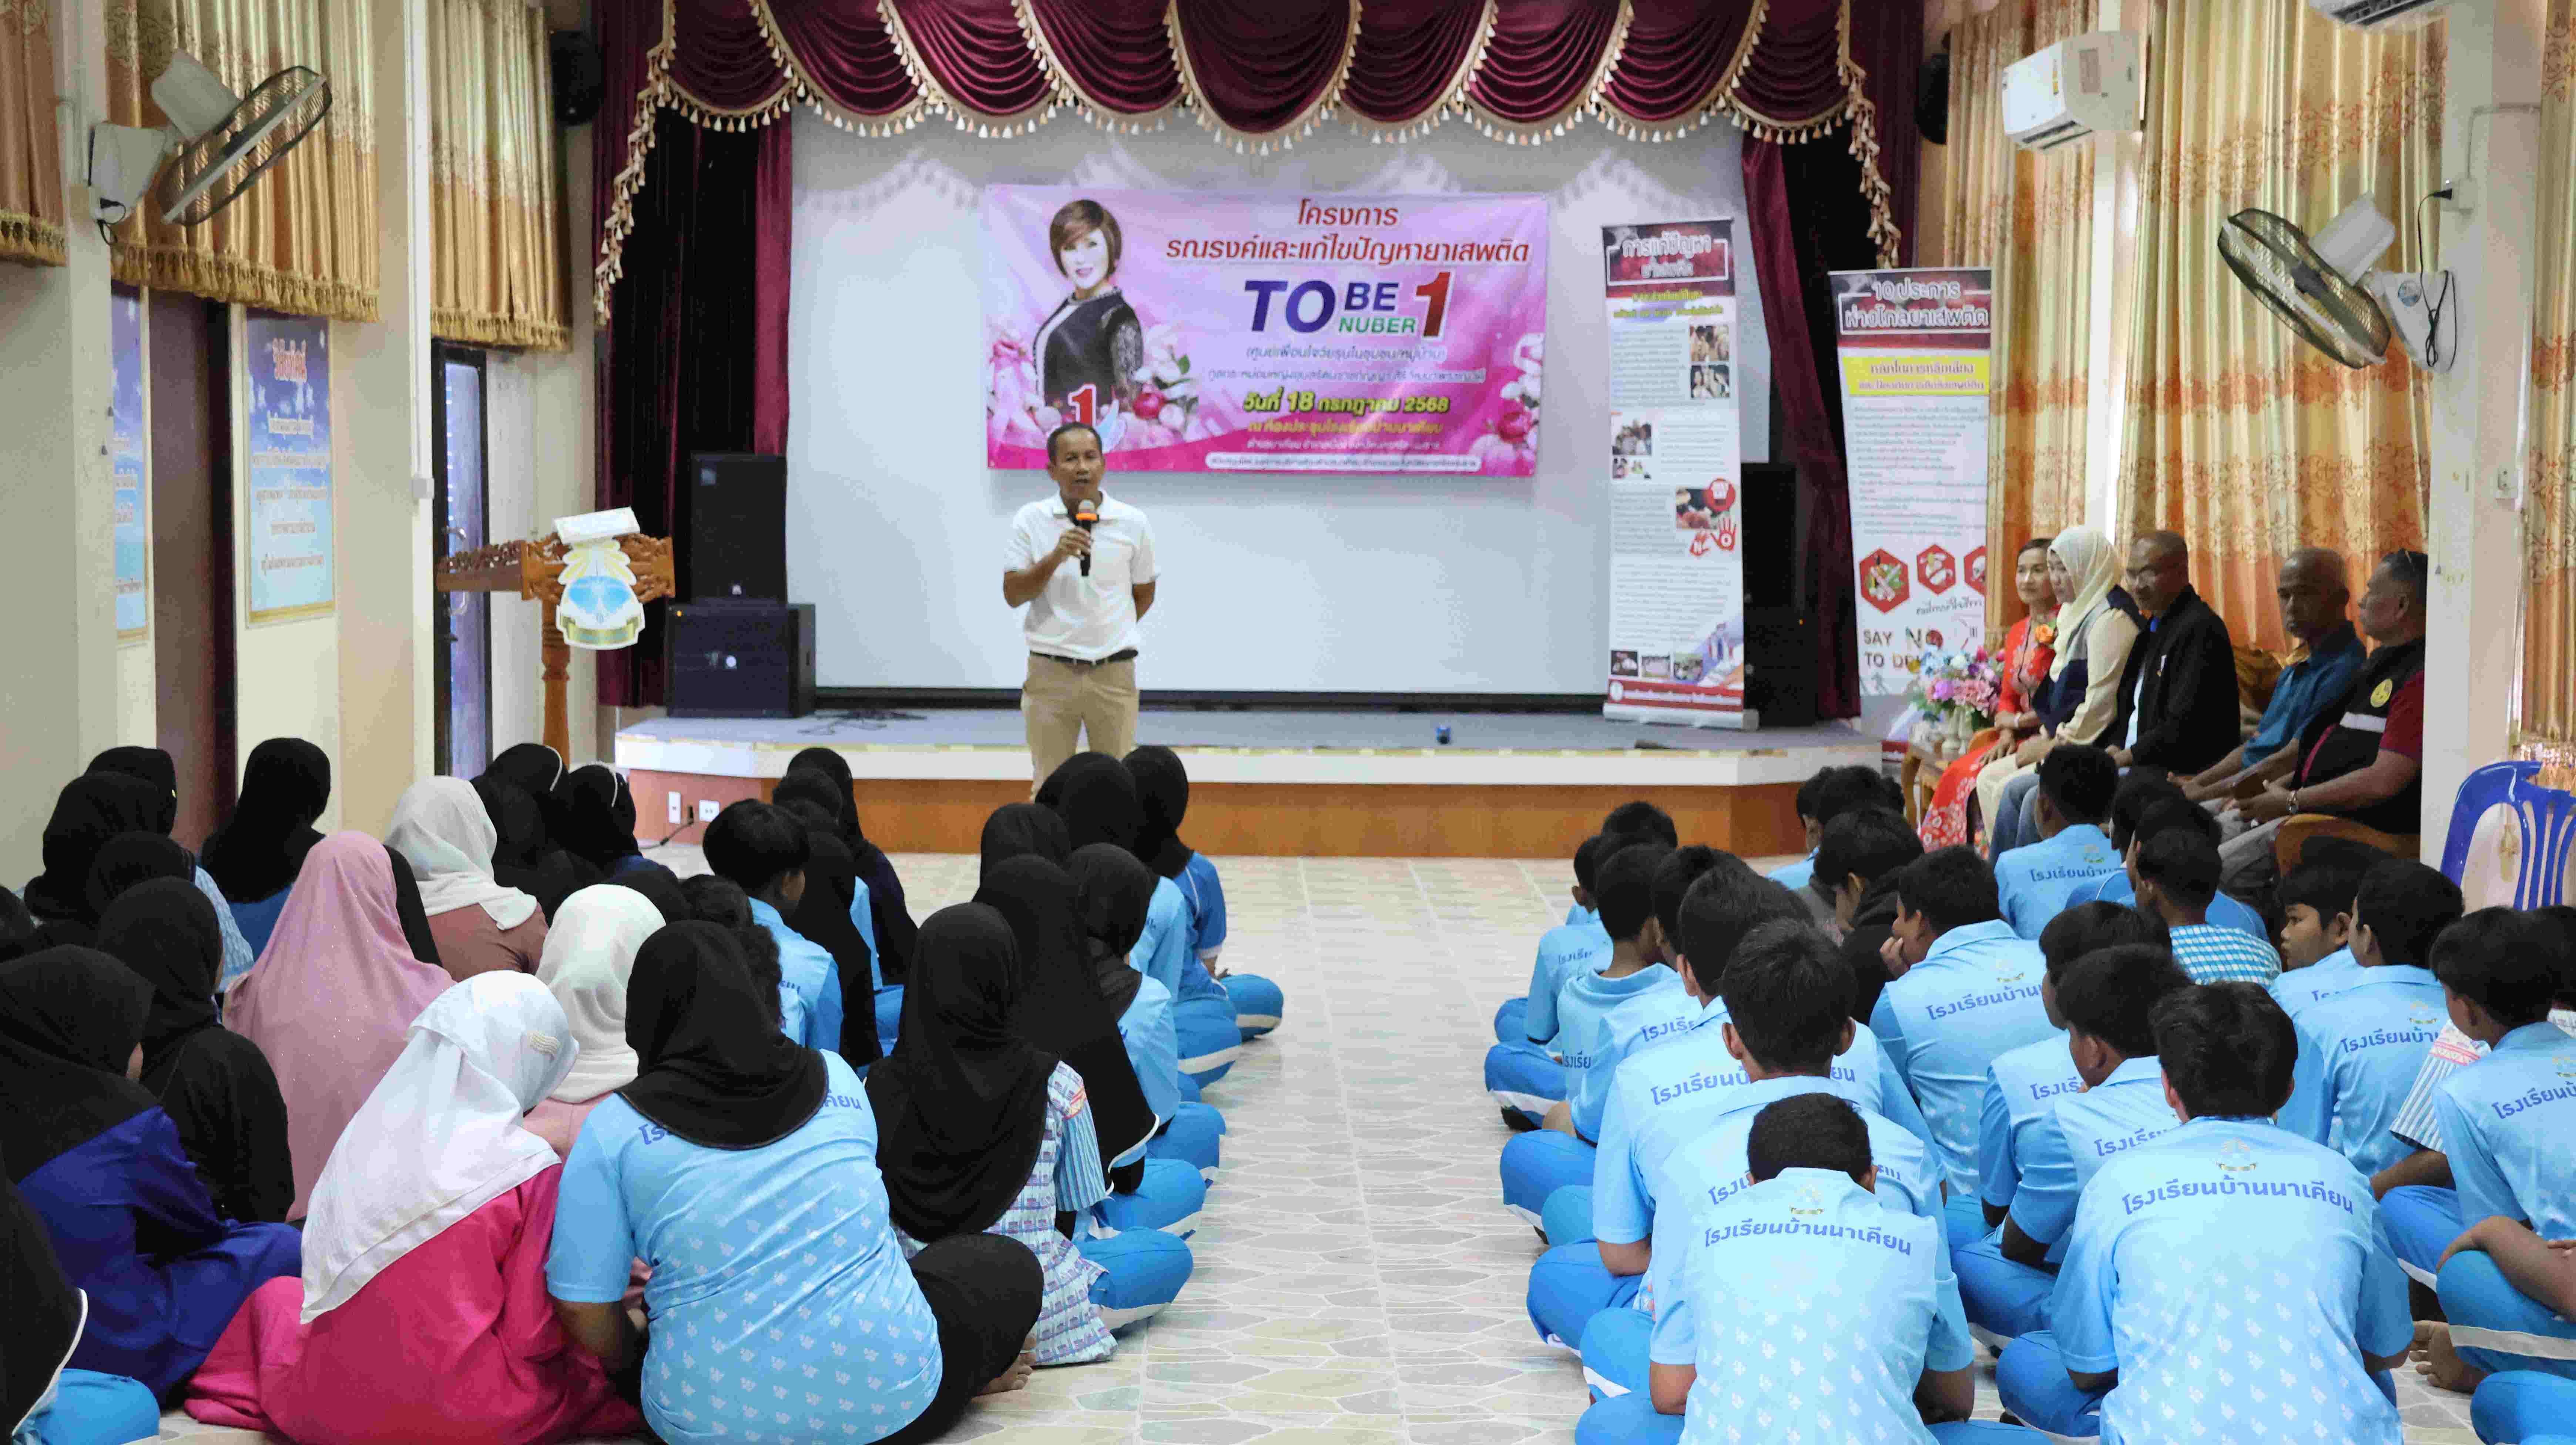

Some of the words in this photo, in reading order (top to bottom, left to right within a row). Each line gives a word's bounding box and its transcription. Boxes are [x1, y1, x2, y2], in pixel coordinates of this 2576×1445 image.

[1298, 198, 1398, 225] โครงการ
[1167, 233, 1529, 265] รณรงค์และแก้ไขปัญหายาเสพติด
[1244, 281, 1336, 333] TO
[1344, 282, 1399, 310] BE
[1416, 272, 1450, 337] 1
[1339, 317, 1416, 333] NUBER
[1244, 386, 1285, 412] วันที่
[1288, 391, 1315, 412] 18
[1318, 398, 1401, 416] กรกฎาคม
[1404, 396, 1450, 413] 2568
[1864, 630, 1892, 646] SAY
[1864, 651, 1884, 668] TO
[1926, 984, 2042, 1020] โรงเรียนบ้าน
[2340, 1027, 2439, 1053] โรงเรียนบ้า
[2122, 1175, 2354, 1215] โรงเรียนบ้านนาเคียน
[1705, 1217, 1911, 1255] โรงเรียนบ้านนาเคียน
